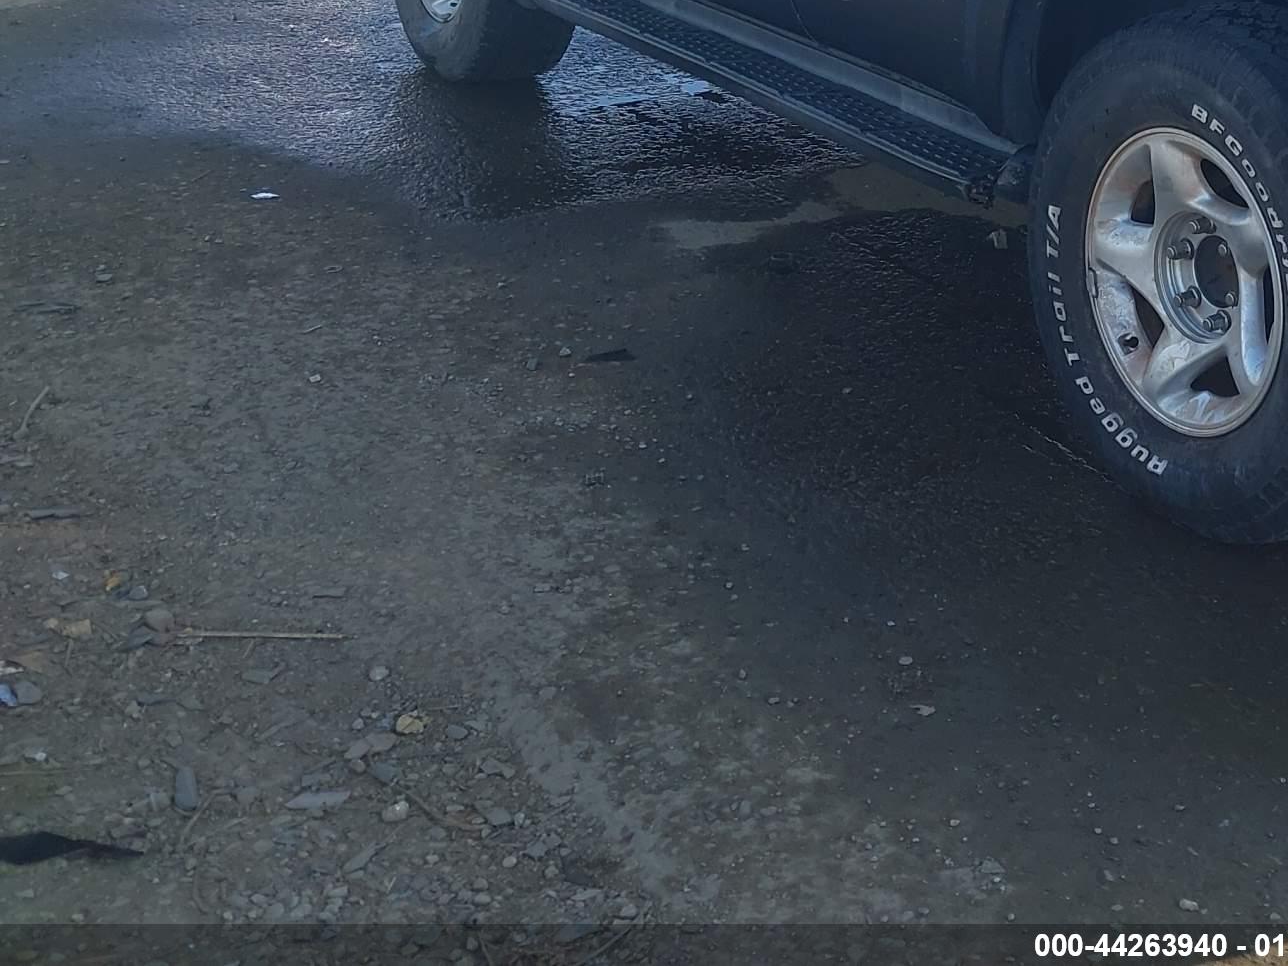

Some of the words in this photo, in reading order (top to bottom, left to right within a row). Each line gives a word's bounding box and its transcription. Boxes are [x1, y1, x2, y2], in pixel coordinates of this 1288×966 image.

[1046, 204, 1063, 260] T/A
[1047, 270, 1080, 367] Trail
[1075, 376, 1168, 475] Rugged
